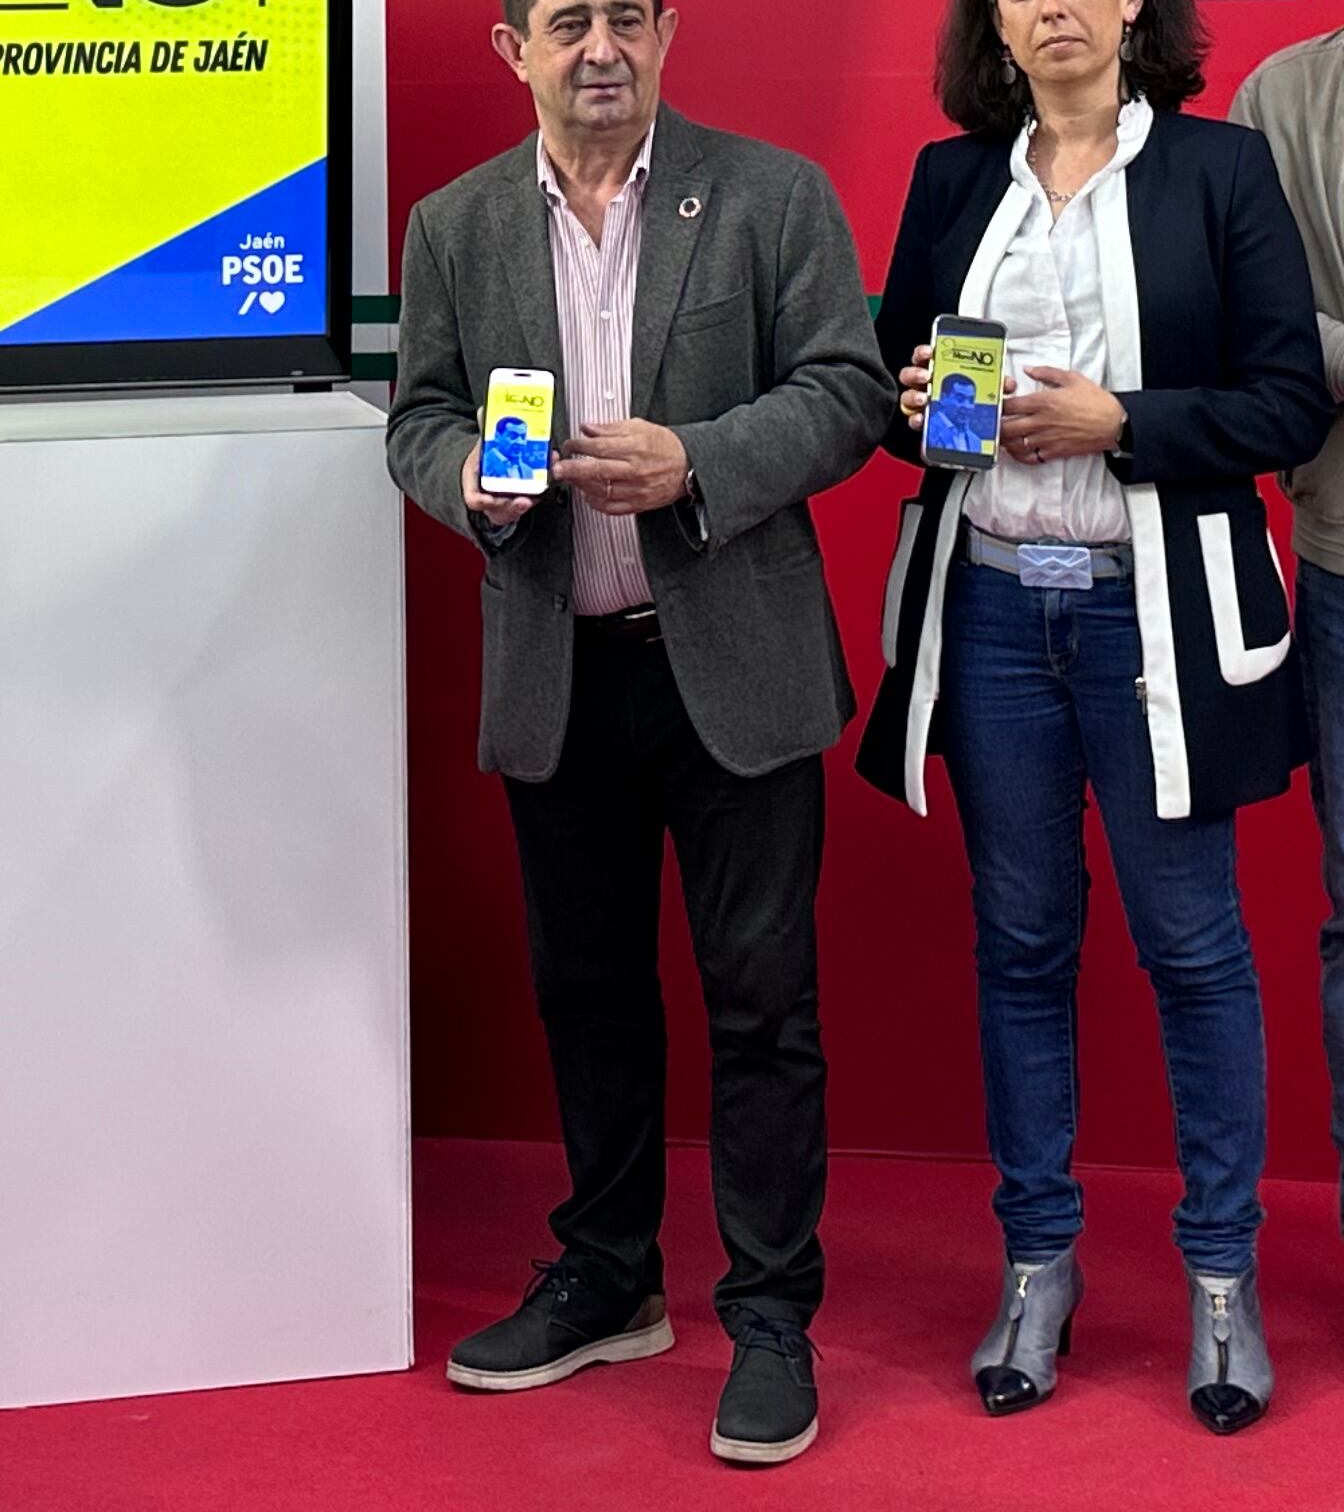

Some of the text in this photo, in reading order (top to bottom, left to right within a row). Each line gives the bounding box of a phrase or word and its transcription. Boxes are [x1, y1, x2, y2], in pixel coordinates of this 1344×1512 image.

[149, 41, 189, 73] DE
[193, 31, 268, 73] JAÉN
[239, 231, 285, 250] Jaén
[222, 254, 304, 286] PSOE
